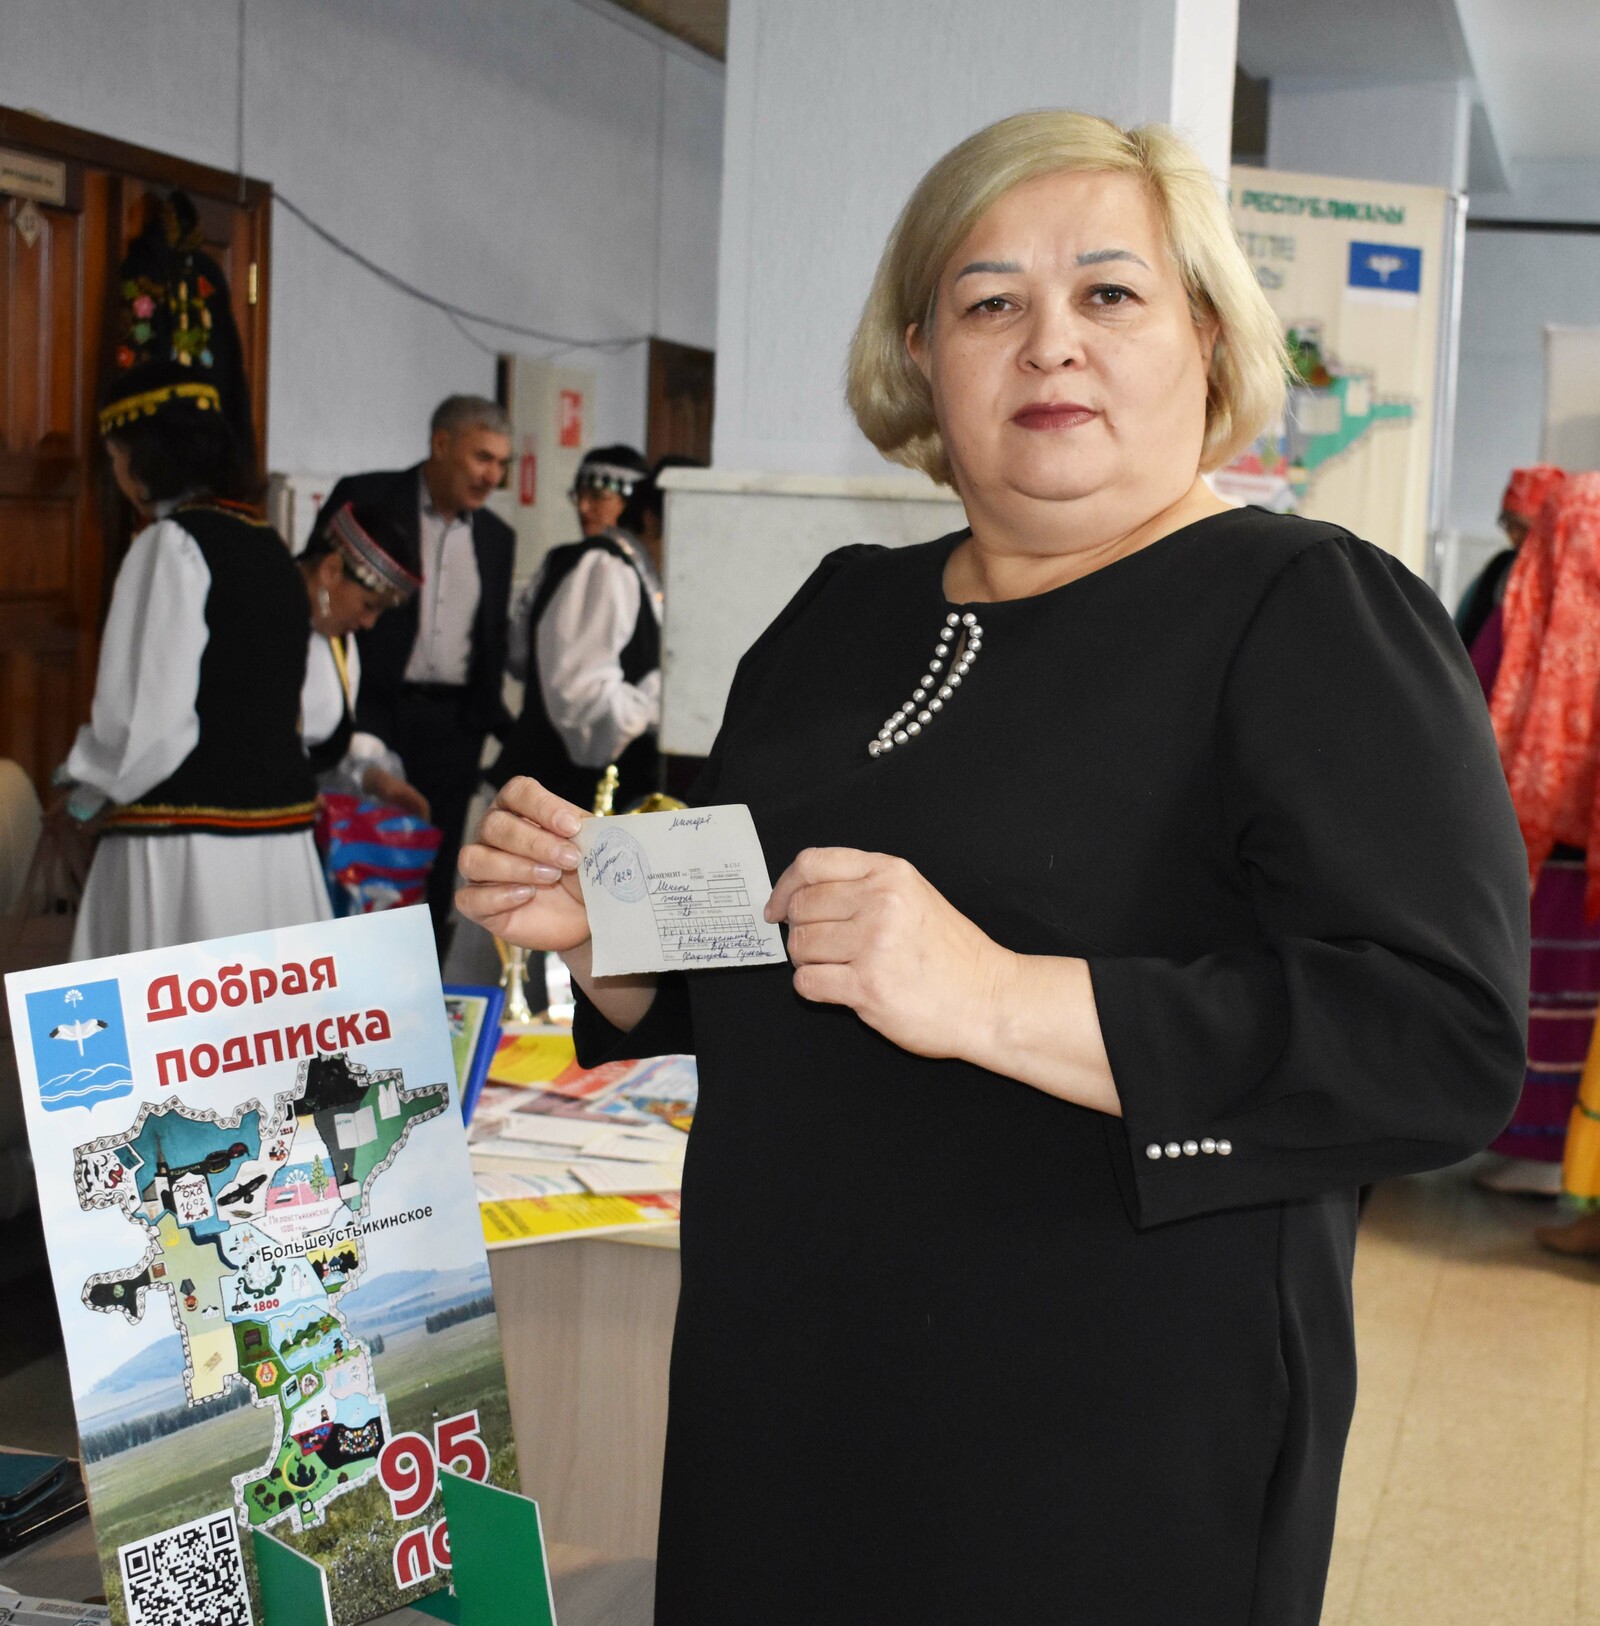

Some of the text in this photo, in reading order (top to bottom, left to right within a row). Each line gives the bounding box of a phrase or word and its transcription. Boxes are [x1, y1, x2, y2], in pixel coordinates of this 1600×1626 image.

[146, 955, 338, 1023] Добрая
[155, 1008, 392, 1087] подписка
[260, 1204, 433, 1263] Большеустьикинское
[252, 1298, 280, 1313] 1800
[379, 1412, 489, 1518] 95
